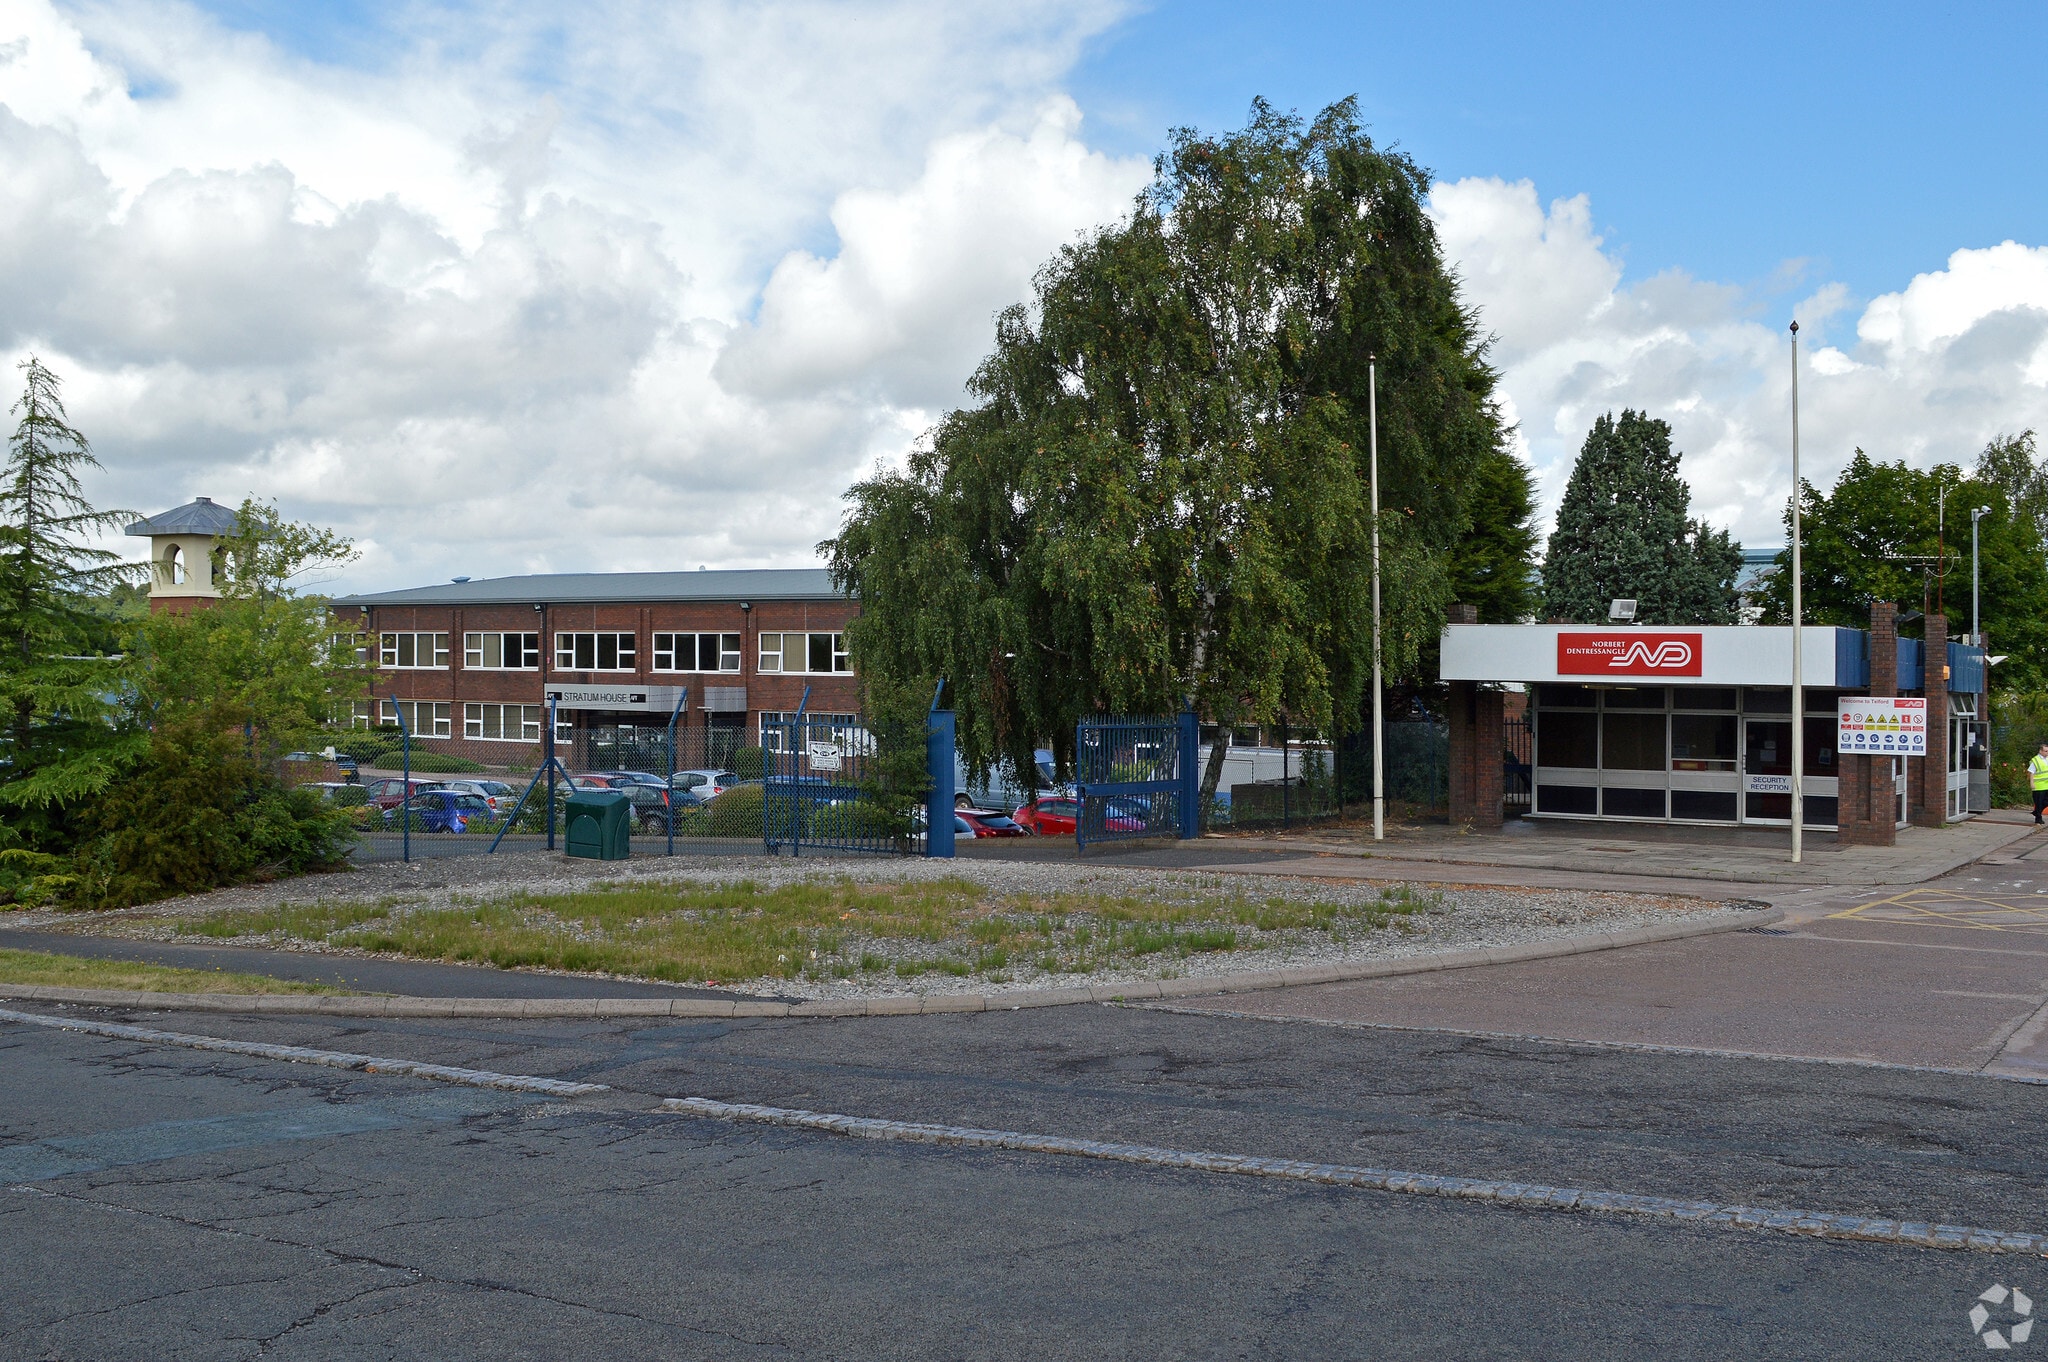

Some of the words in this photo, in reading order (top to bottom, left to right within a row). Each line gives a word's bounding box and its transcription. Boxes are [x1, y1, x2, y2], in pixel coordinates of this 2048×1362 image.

[564, 692, 599, 702] STRATUM
[600, 693, 627, 703] HOUSE
[1753, 776, 1787, 784] SECURITY
